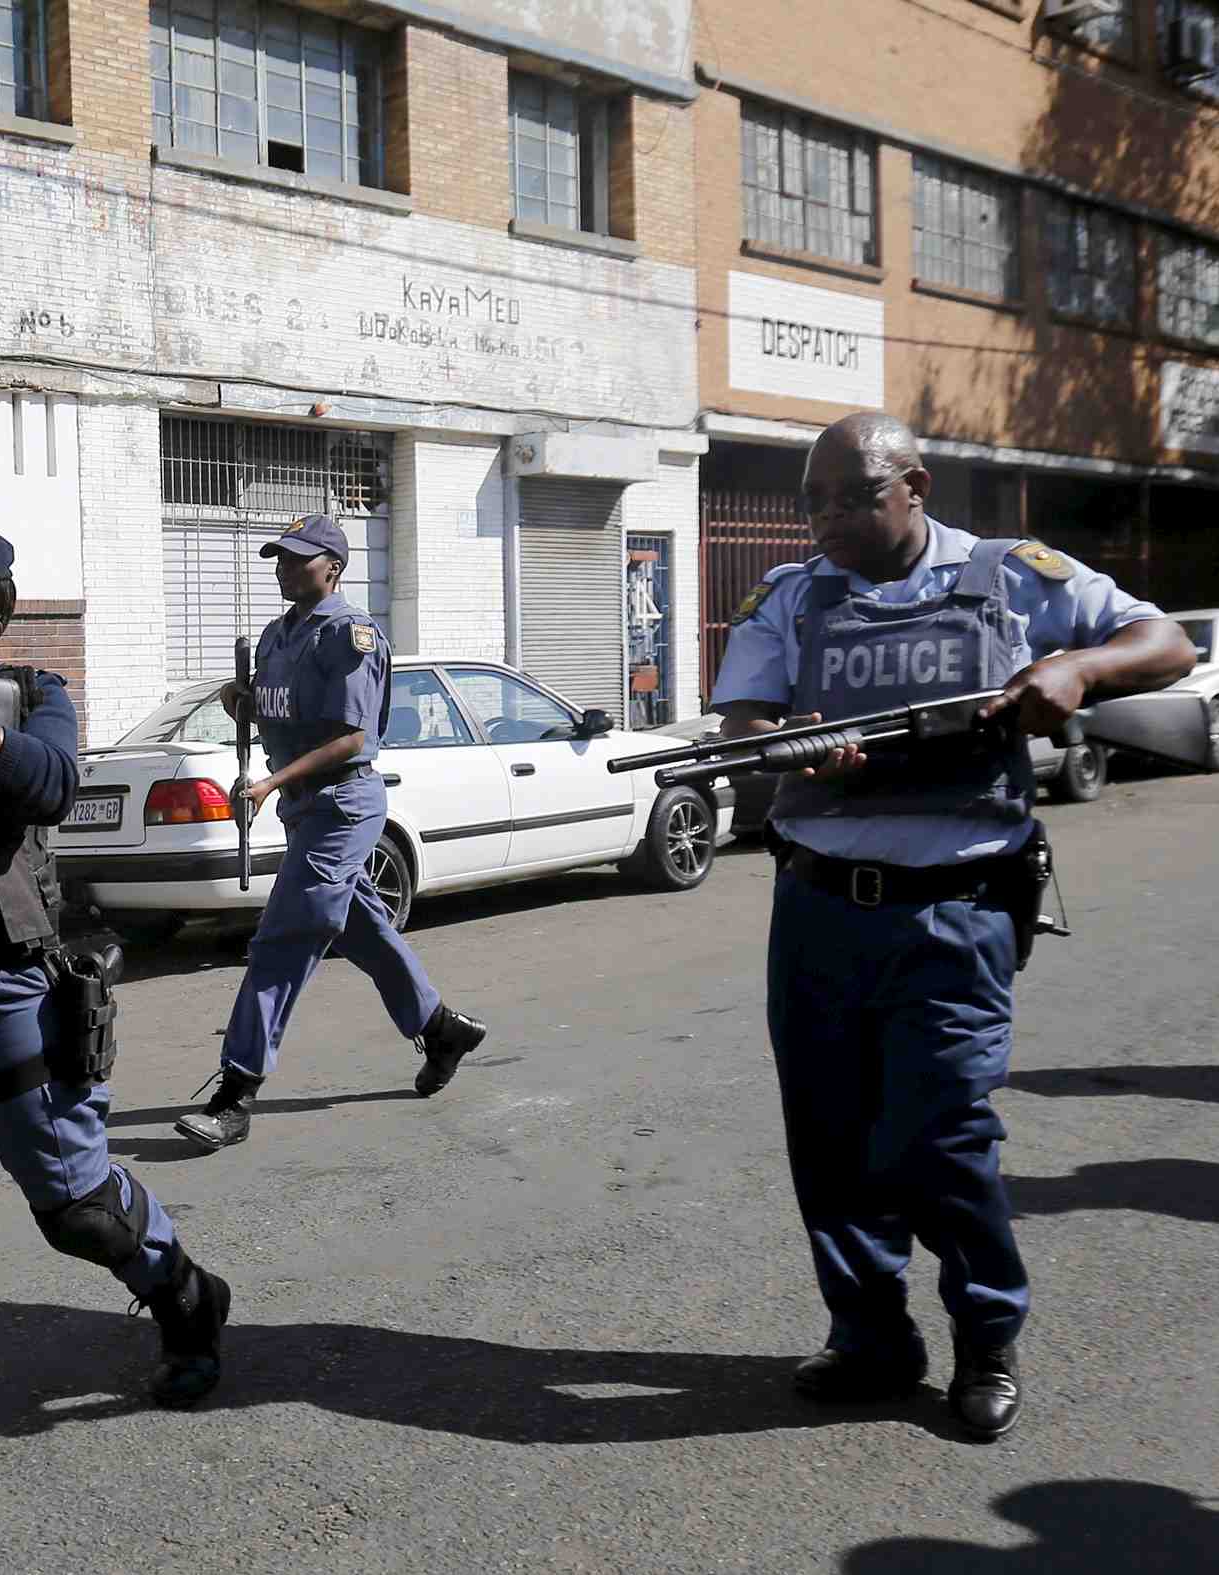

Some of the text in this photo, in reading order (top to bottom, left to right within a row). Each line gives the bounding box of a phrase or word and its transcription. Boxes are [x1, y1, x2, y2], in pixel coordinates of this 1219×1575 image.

[761, 318, 859, 370] DESPATCH
[820, 638, 964, 691] POLICE
[254, 686, 291, 718] POLICE
[106, 801, 119, 820] GP
